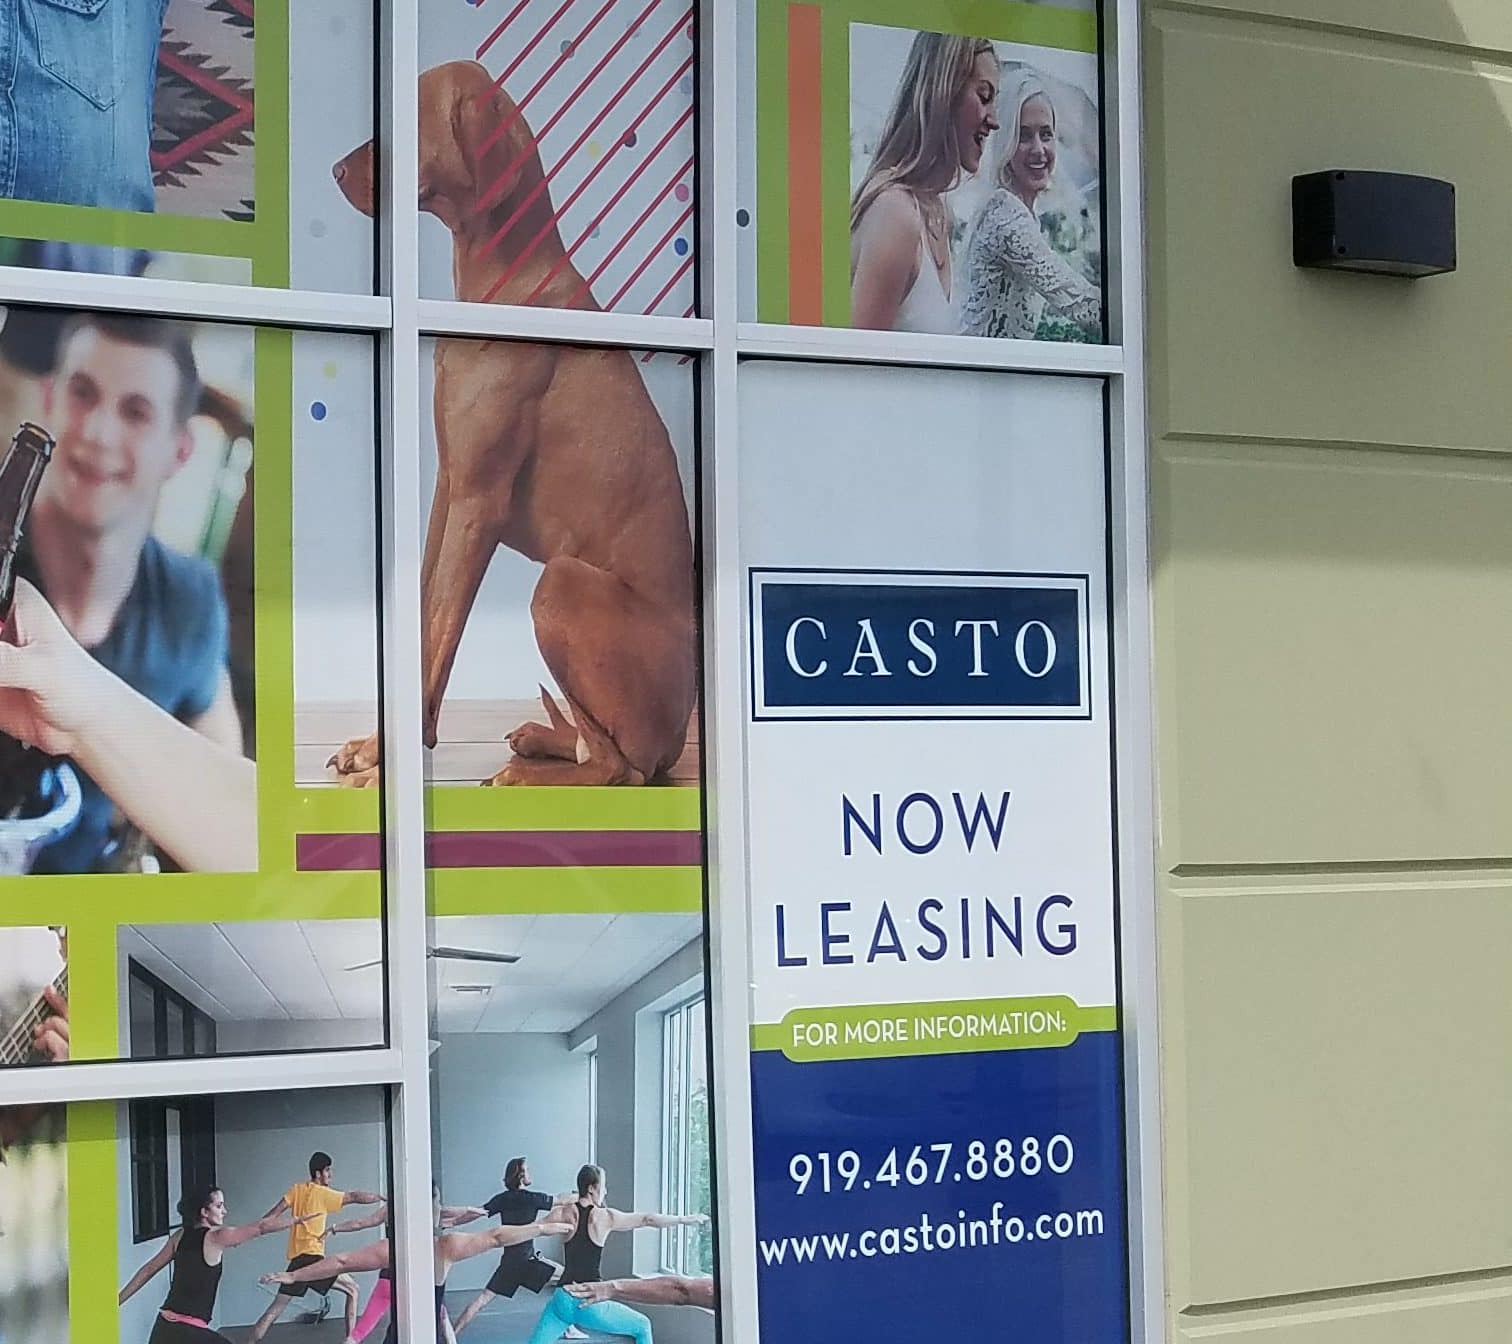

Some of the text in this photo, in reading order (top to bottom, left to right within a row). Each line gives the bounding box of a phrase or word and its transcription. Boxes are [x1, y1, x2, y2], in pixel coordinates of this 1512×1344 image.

[785, 616, 1057, 678] CASTO
[842, 791, 1011, 856] NOW
[775, 895, 1078, 968] LEASING
[792, 1010, 1067, 1047] FOR MORE INFORMATION:
[788, 1134, 1074, 1195] 919.467.8880
[760, 1202, 1104, 1265] www.castoinfo.com
